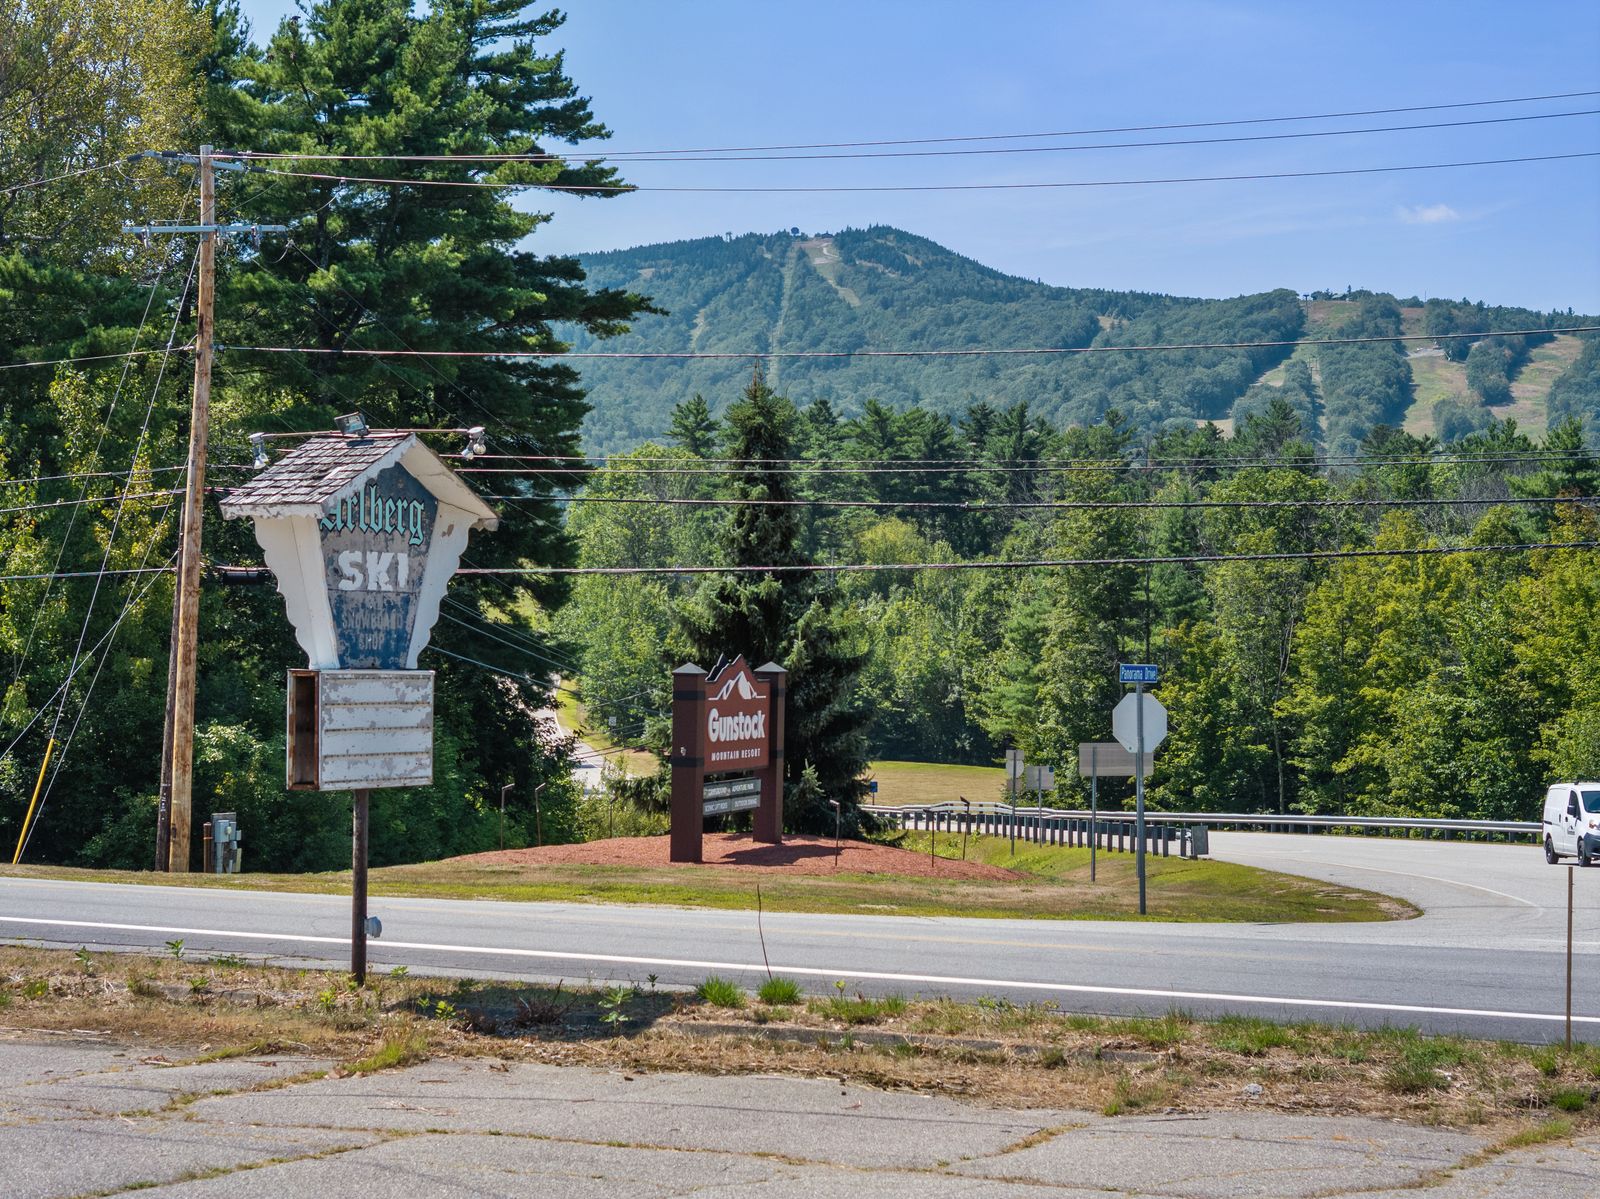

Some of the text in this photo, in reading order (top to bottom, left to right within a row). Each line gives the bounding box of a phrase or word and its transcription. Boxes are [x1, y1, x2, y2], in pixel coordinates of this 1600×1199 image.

[319, 483, 425, 547] Arlberg
[338, 550, 409, 592] SKI
[358, 632, 385, 651] SHOP
[708, 708, 766, 743] Gunstock
[711, 748, 761, 762] MOUNTAIN RESORT
